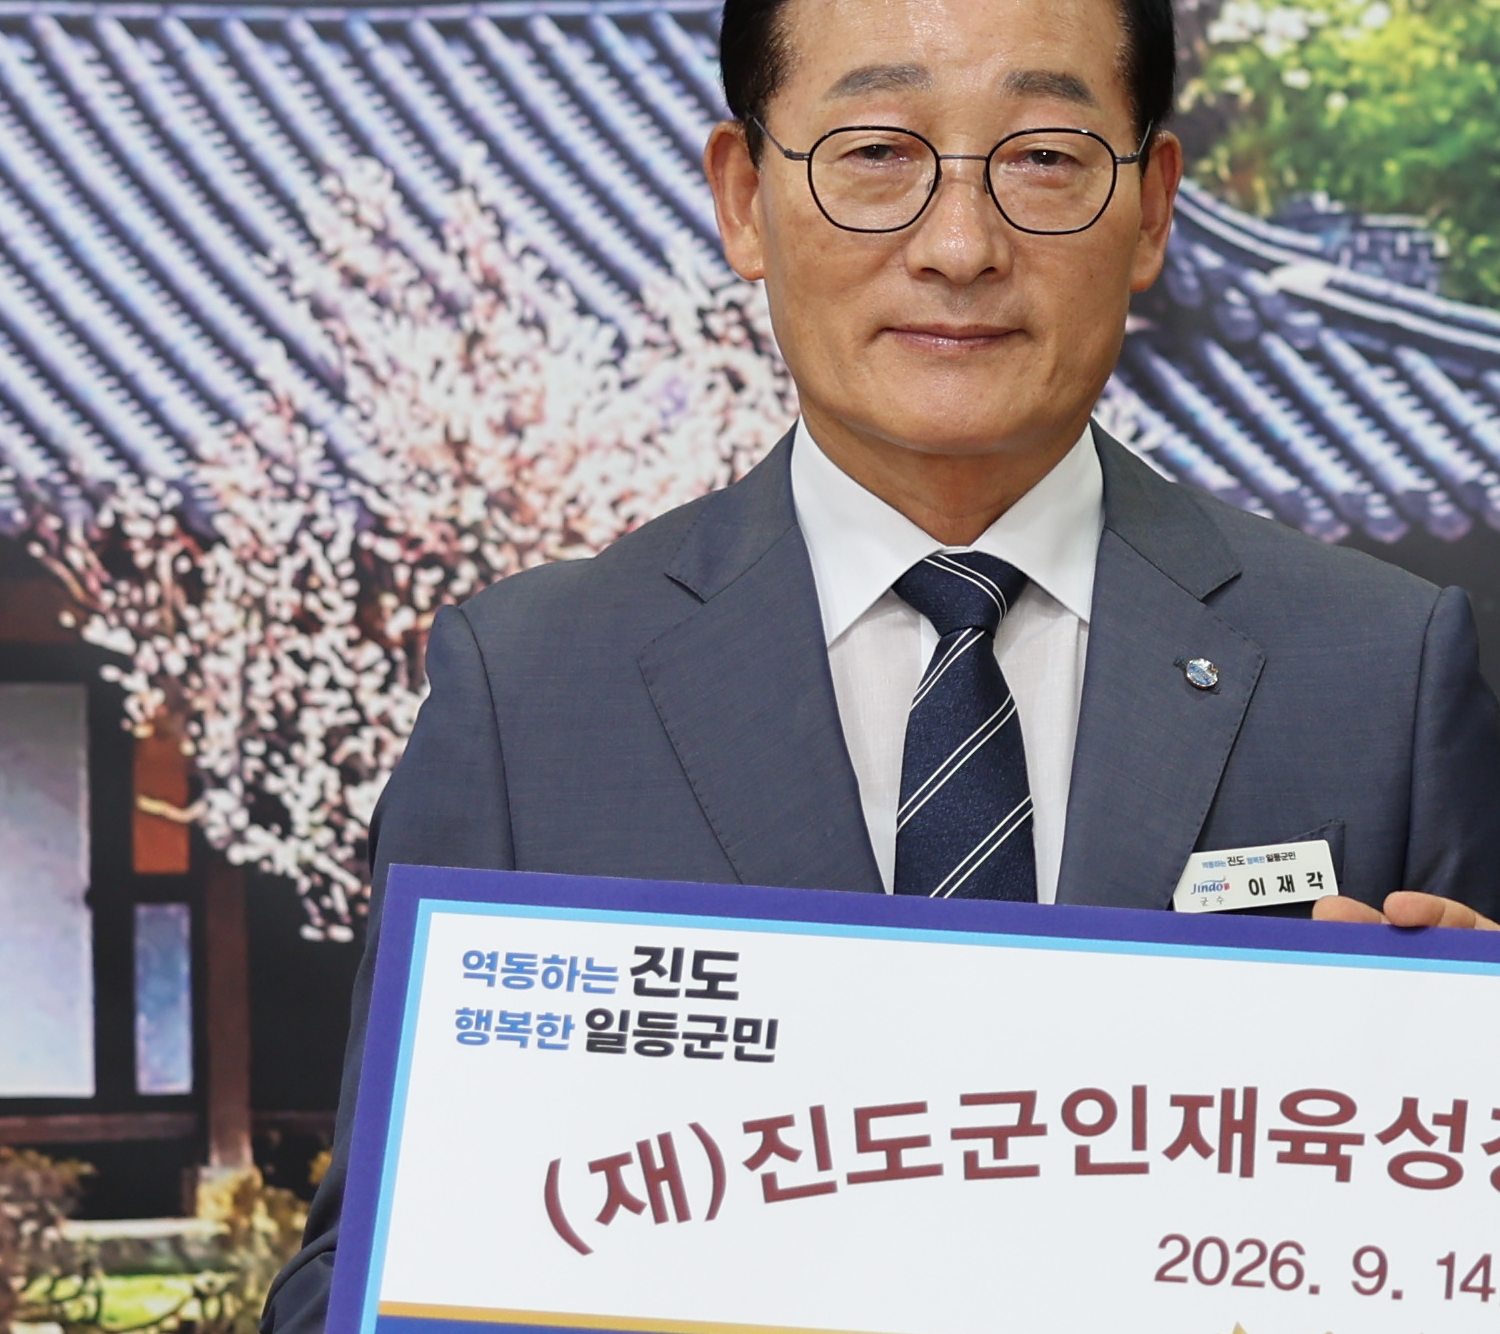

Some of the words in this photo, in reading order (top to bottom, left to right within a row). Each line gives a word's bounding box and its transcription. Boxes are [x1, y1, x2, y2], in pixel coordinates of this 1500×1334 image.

[1227, 856, 1245, 867] 진도
[1266, 851, 1296, 862] 일등군민
[1191, 881, 1223, 895] Jindo
[463, 951, 618, 994] 역동하는
[630, 946, 739, 1000] 진도
[456, 1008, 574, 1050] 행복한
[586, 1008, 778, 1063] 일등군민
[1155, 1234, 1319, 1294] 2026.
[1353, 1246, 1402, 1300] 9.
